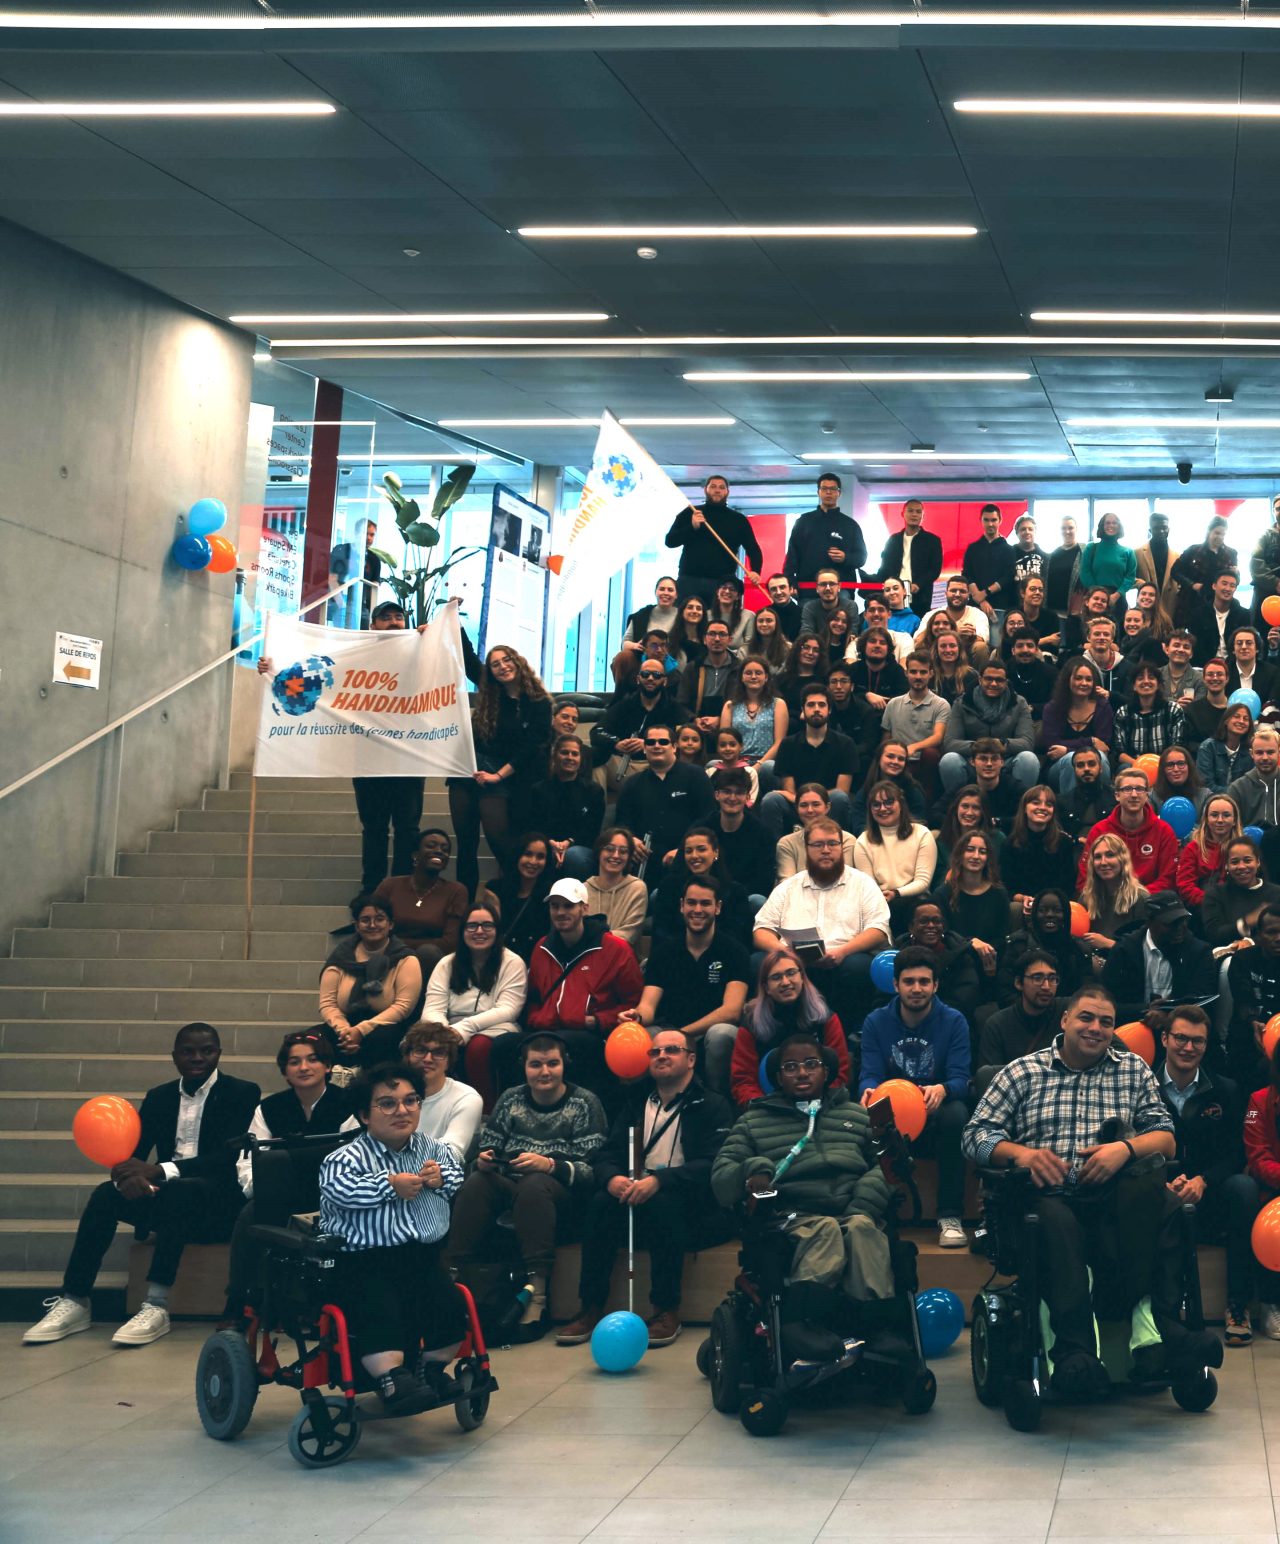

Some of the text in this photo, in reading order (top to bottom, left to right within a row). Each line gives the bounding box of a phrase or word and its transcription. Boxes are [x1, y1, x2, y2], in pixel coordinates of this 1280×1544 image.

[59, 647, 74, 656] SALLE
[83, 651, 97, 660] REPOS
[342, 669, 399, 692] 100%
[330, 683, 456, 715] HANDINAMIQUE
[269, 722, 459, 741] pour la réussite des jeunes handicapés
